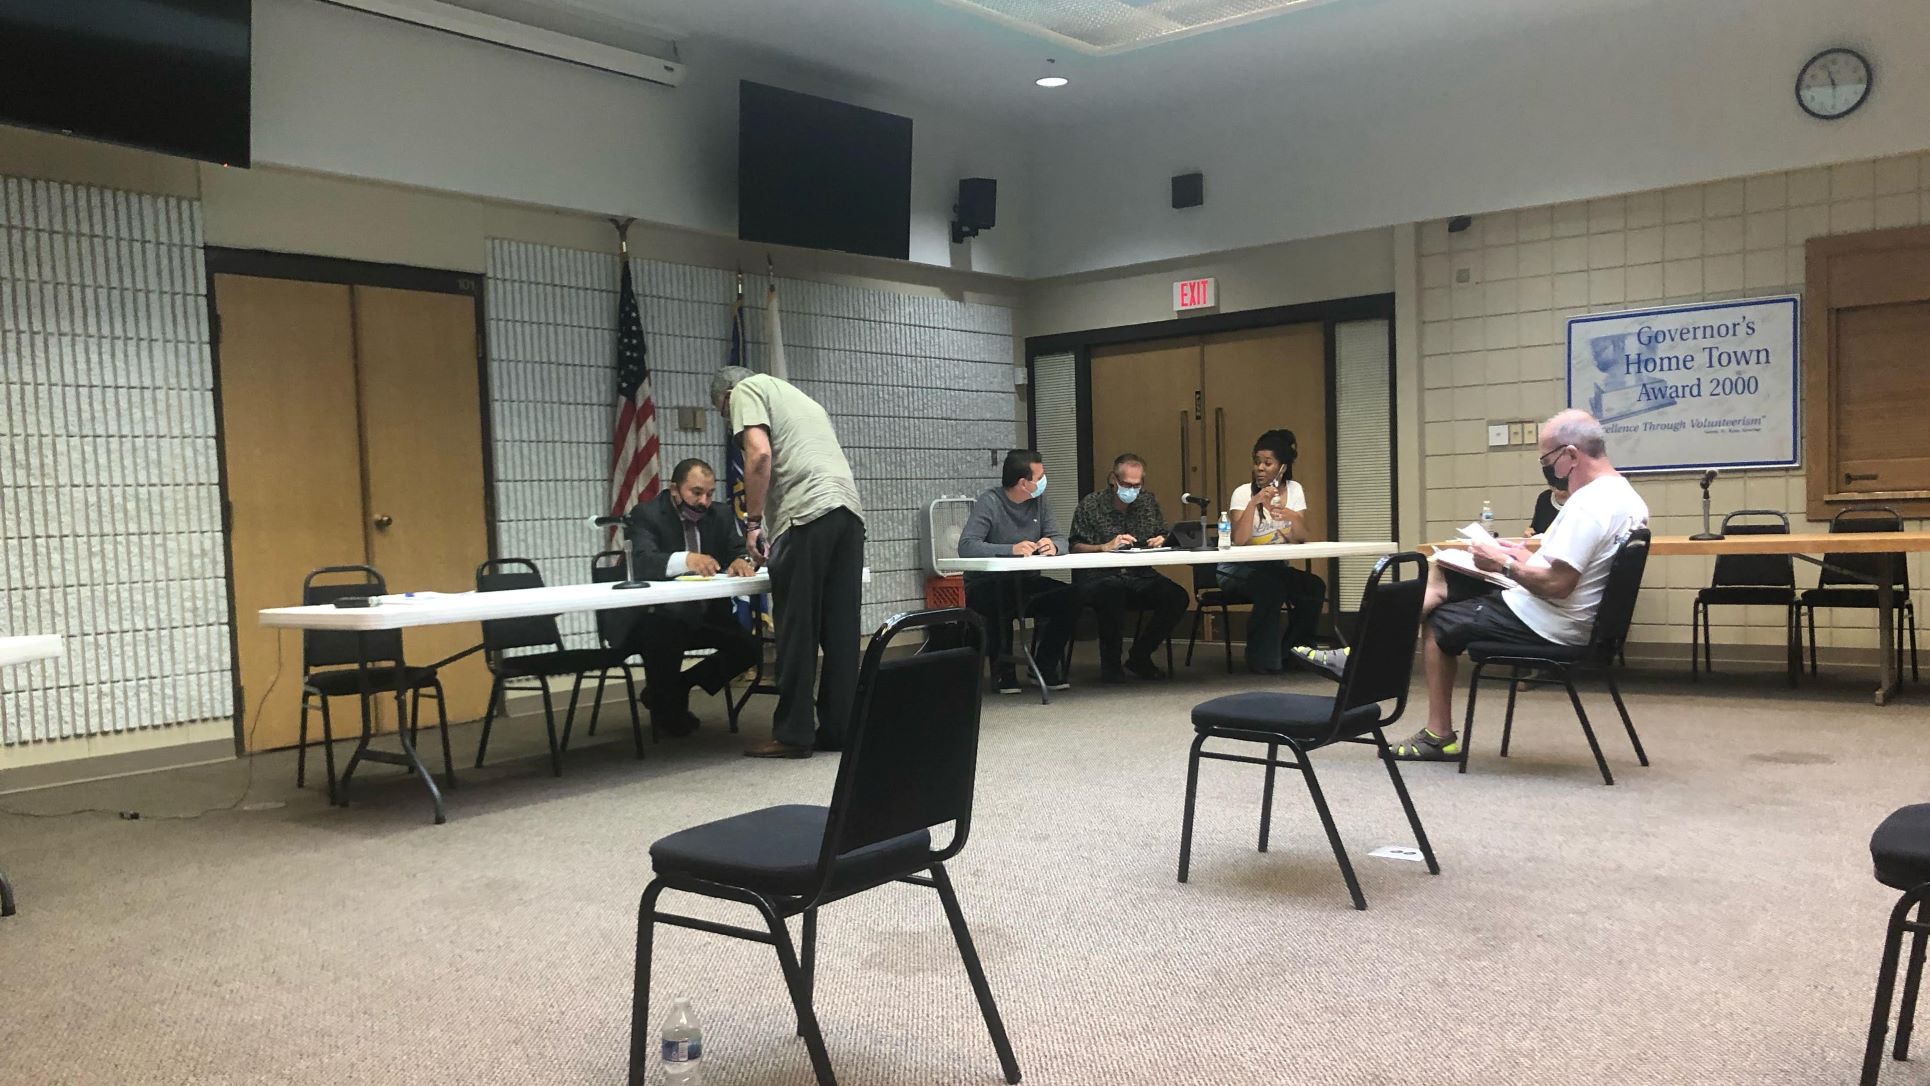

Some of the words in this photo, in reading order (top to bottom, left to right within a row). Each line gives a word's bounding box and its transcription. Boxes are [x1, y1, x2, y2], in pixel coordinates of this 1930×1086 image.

[1180, 280, 1208, 307] EXIT
[1636, 316, 1756, 346] Governor's
[1624, 353, 1695, 375] Home
[1702, 346, 1771, 369] Town
[1636, 377, 1702, 402] Award
[1709, 375, 1759, 397] 2000
[1642, 420, 1686, 433] Through
